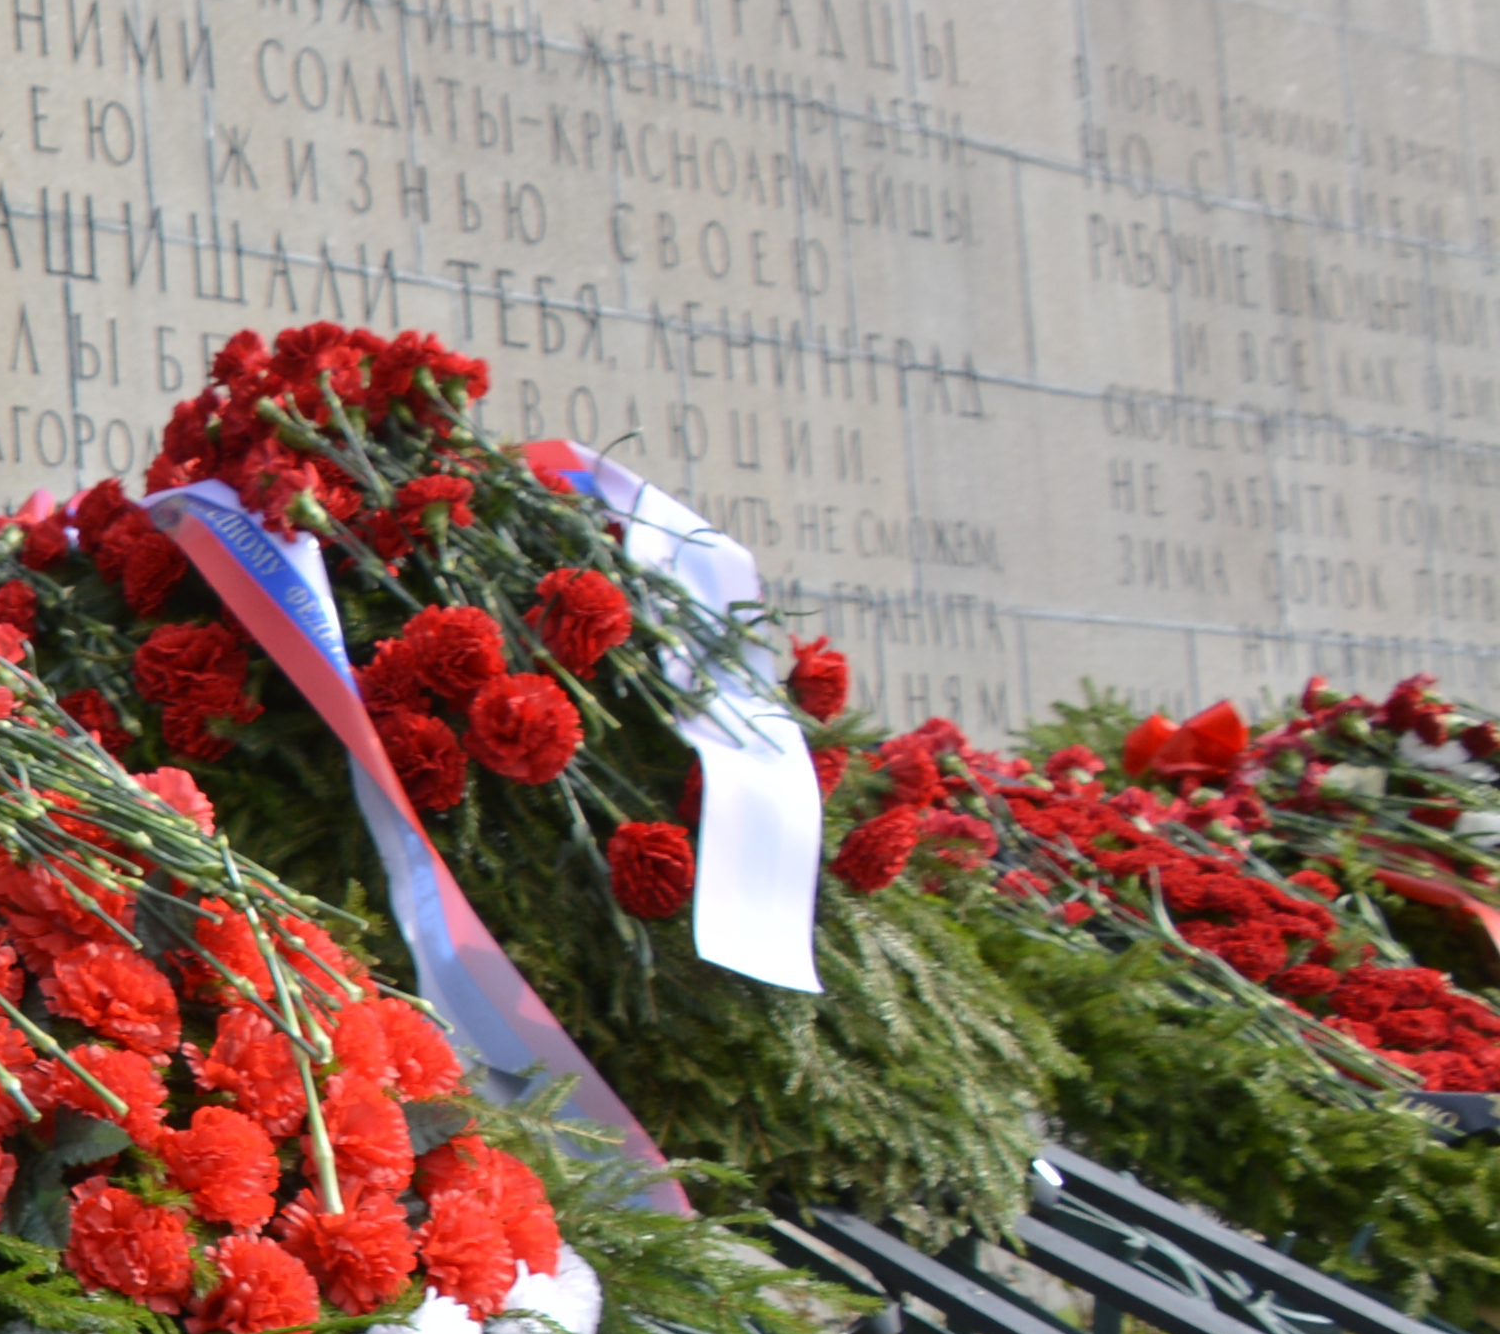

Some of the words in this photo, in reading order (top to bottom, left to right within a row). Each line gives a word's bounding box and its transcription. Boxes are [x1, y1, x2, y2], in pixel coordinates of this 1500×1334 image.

[216, 123, 547, 246] ЖИЗНЬЮ
[610, 201, 830, 298] СВОЕЮ
[794, 503, 844, 555] НЕ
